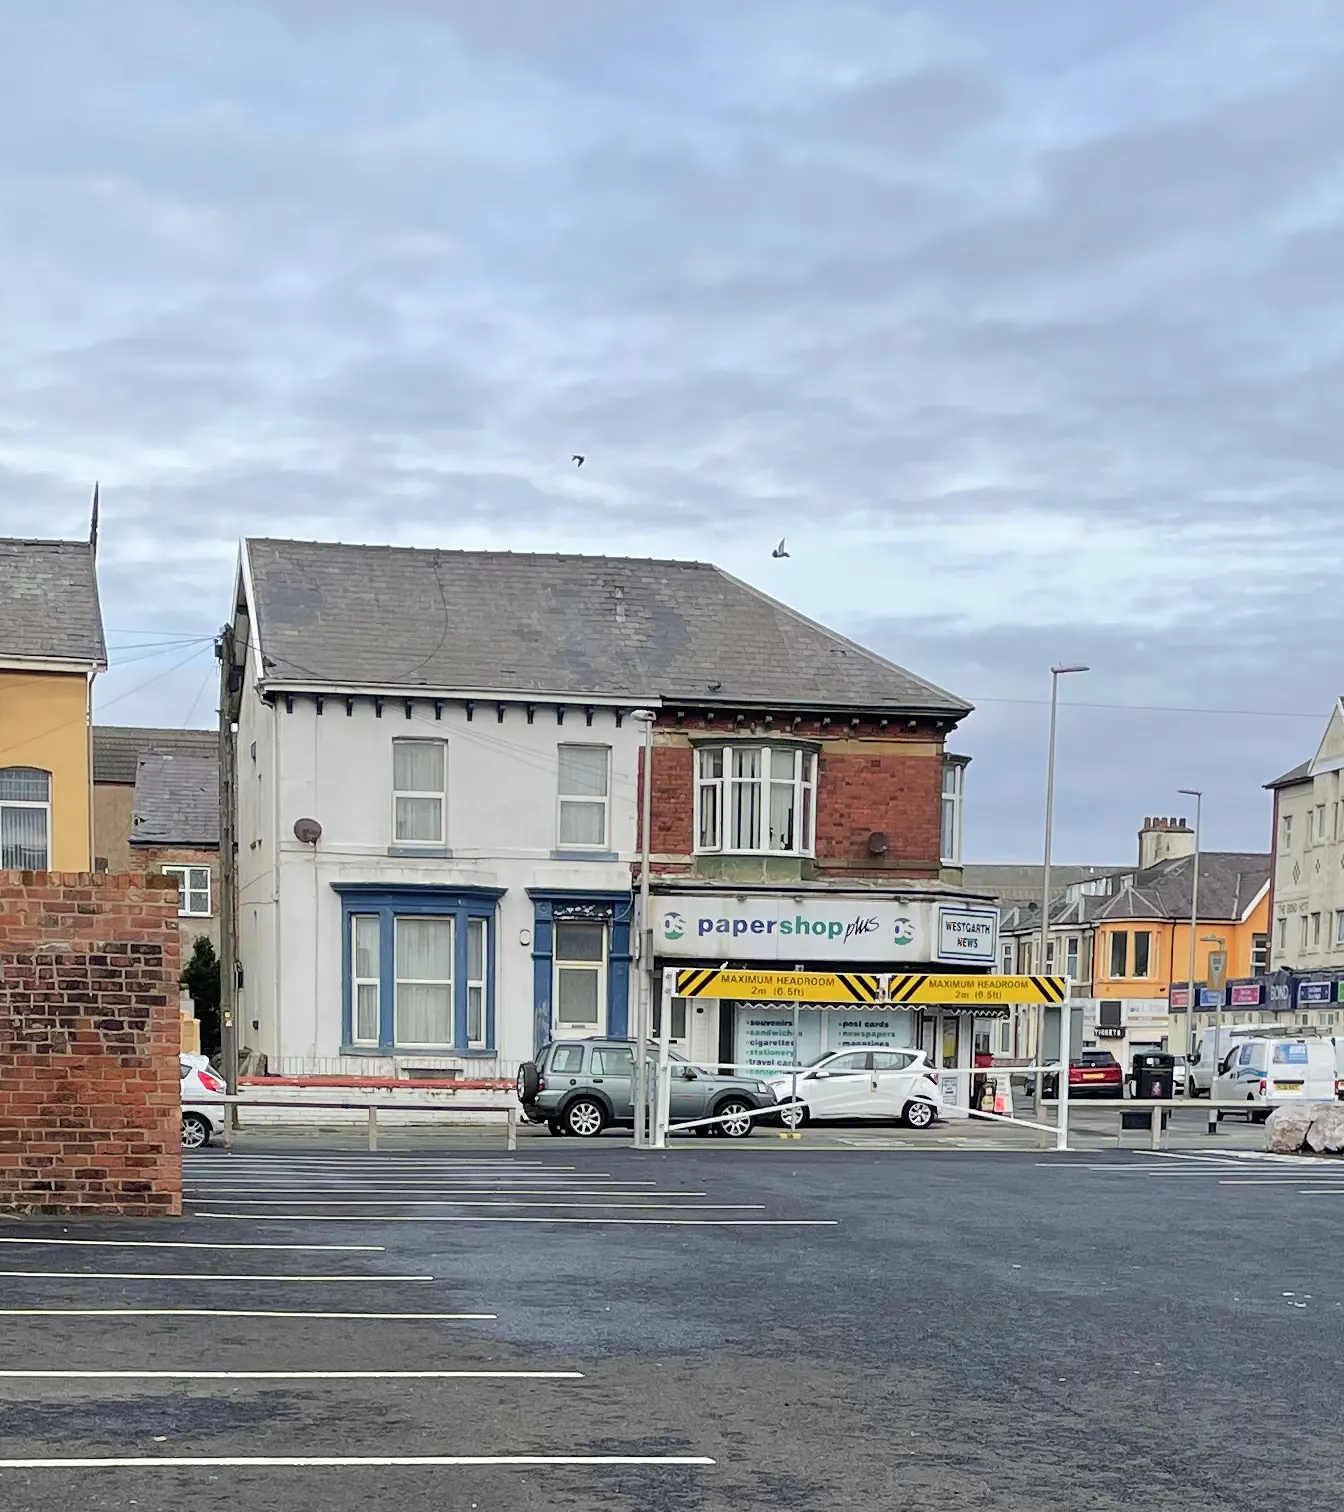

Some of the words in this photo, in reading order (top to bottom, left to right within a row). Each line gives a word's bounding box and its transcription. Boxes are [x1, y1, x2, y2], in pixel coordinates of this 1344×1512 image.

[945, 920, 991, 935] WESTGARTH
[957, 936, 979, 949] NEWS
[720, 974, 773, 985] MAXIMUM
[776, 977, 835, 987] HEADROOM
[928, 980, 975, 989] MAXIMUM
[977, 980, 1029, 989] HEADROOM
[751, 987, 767, 995] 2m
[773, 988, 805, 997] (6.5ft)
[1270, 984, 1289, 1001] BOND
[842, 1020, 862, 1028] post
[864, 1020, 889, 1028] cards
[749, 1029, 803, 1037] sandwichs
[842, 1031, 895, 1039] newspapers
